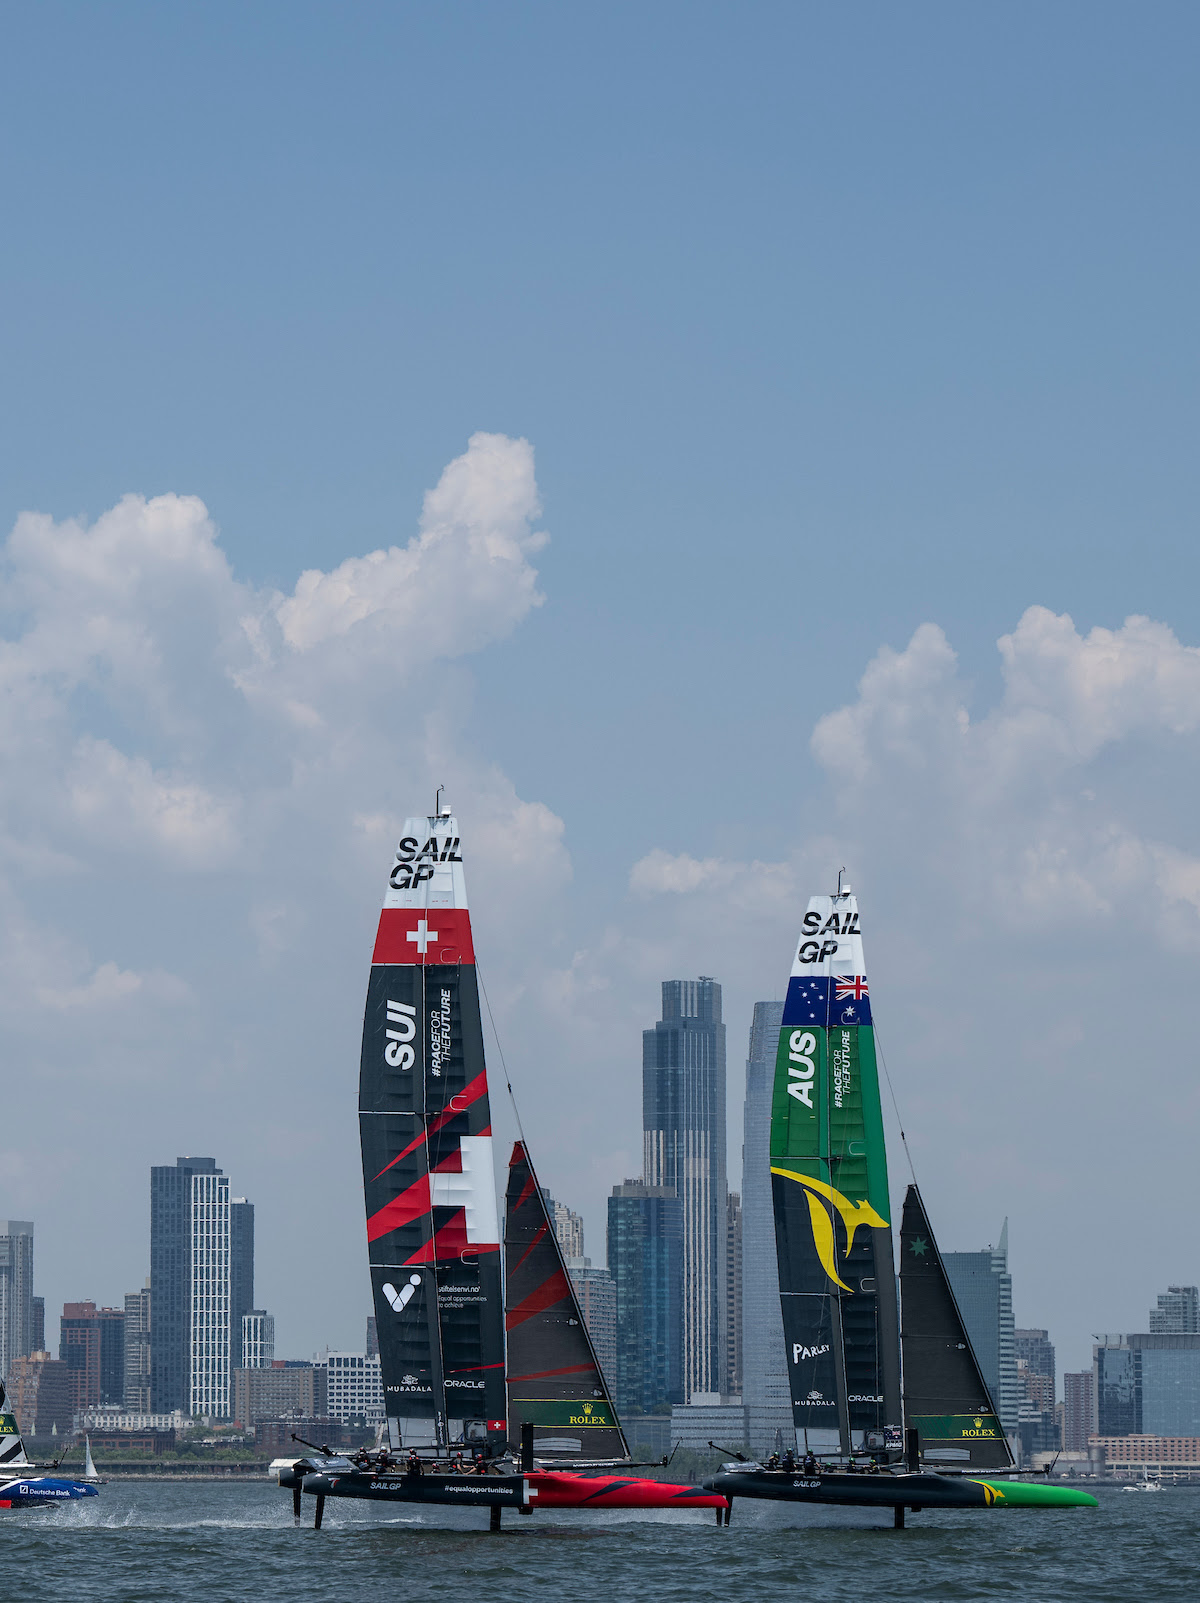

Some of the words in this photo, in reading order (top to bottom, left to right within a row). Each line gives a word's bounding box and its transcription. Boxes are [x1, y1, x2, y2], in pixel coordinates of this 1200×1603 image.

[396, 837, 463, 862] SAIL
[389, 864, 435, 889] GP
[801, 912, 861, 936] SAIL
[798, 940, 838, 964] GP
[385, 1000, 416, 1070] SUI
[441, 988, 451, 1061] THEFUTURE
[431, 1010, 441, 1077] #RACEFOR
[788, 1030, 816, 1109] AUS
[842, 1030, 850, 1095] THEFUTURE
[835, 1050, 843, 1108] #RACEFOR
[444, 1380, 485, 1388] ORACLE
[570, 1416, 606, 1424] ROLEX
[962, 1429, 995, 1437] ROLEX
[29, 1488, 56, 1496] Deutsche
[56, 1489, 71, 1497] Bank
[445, 1484, 513, 1494] #equalopportunities
